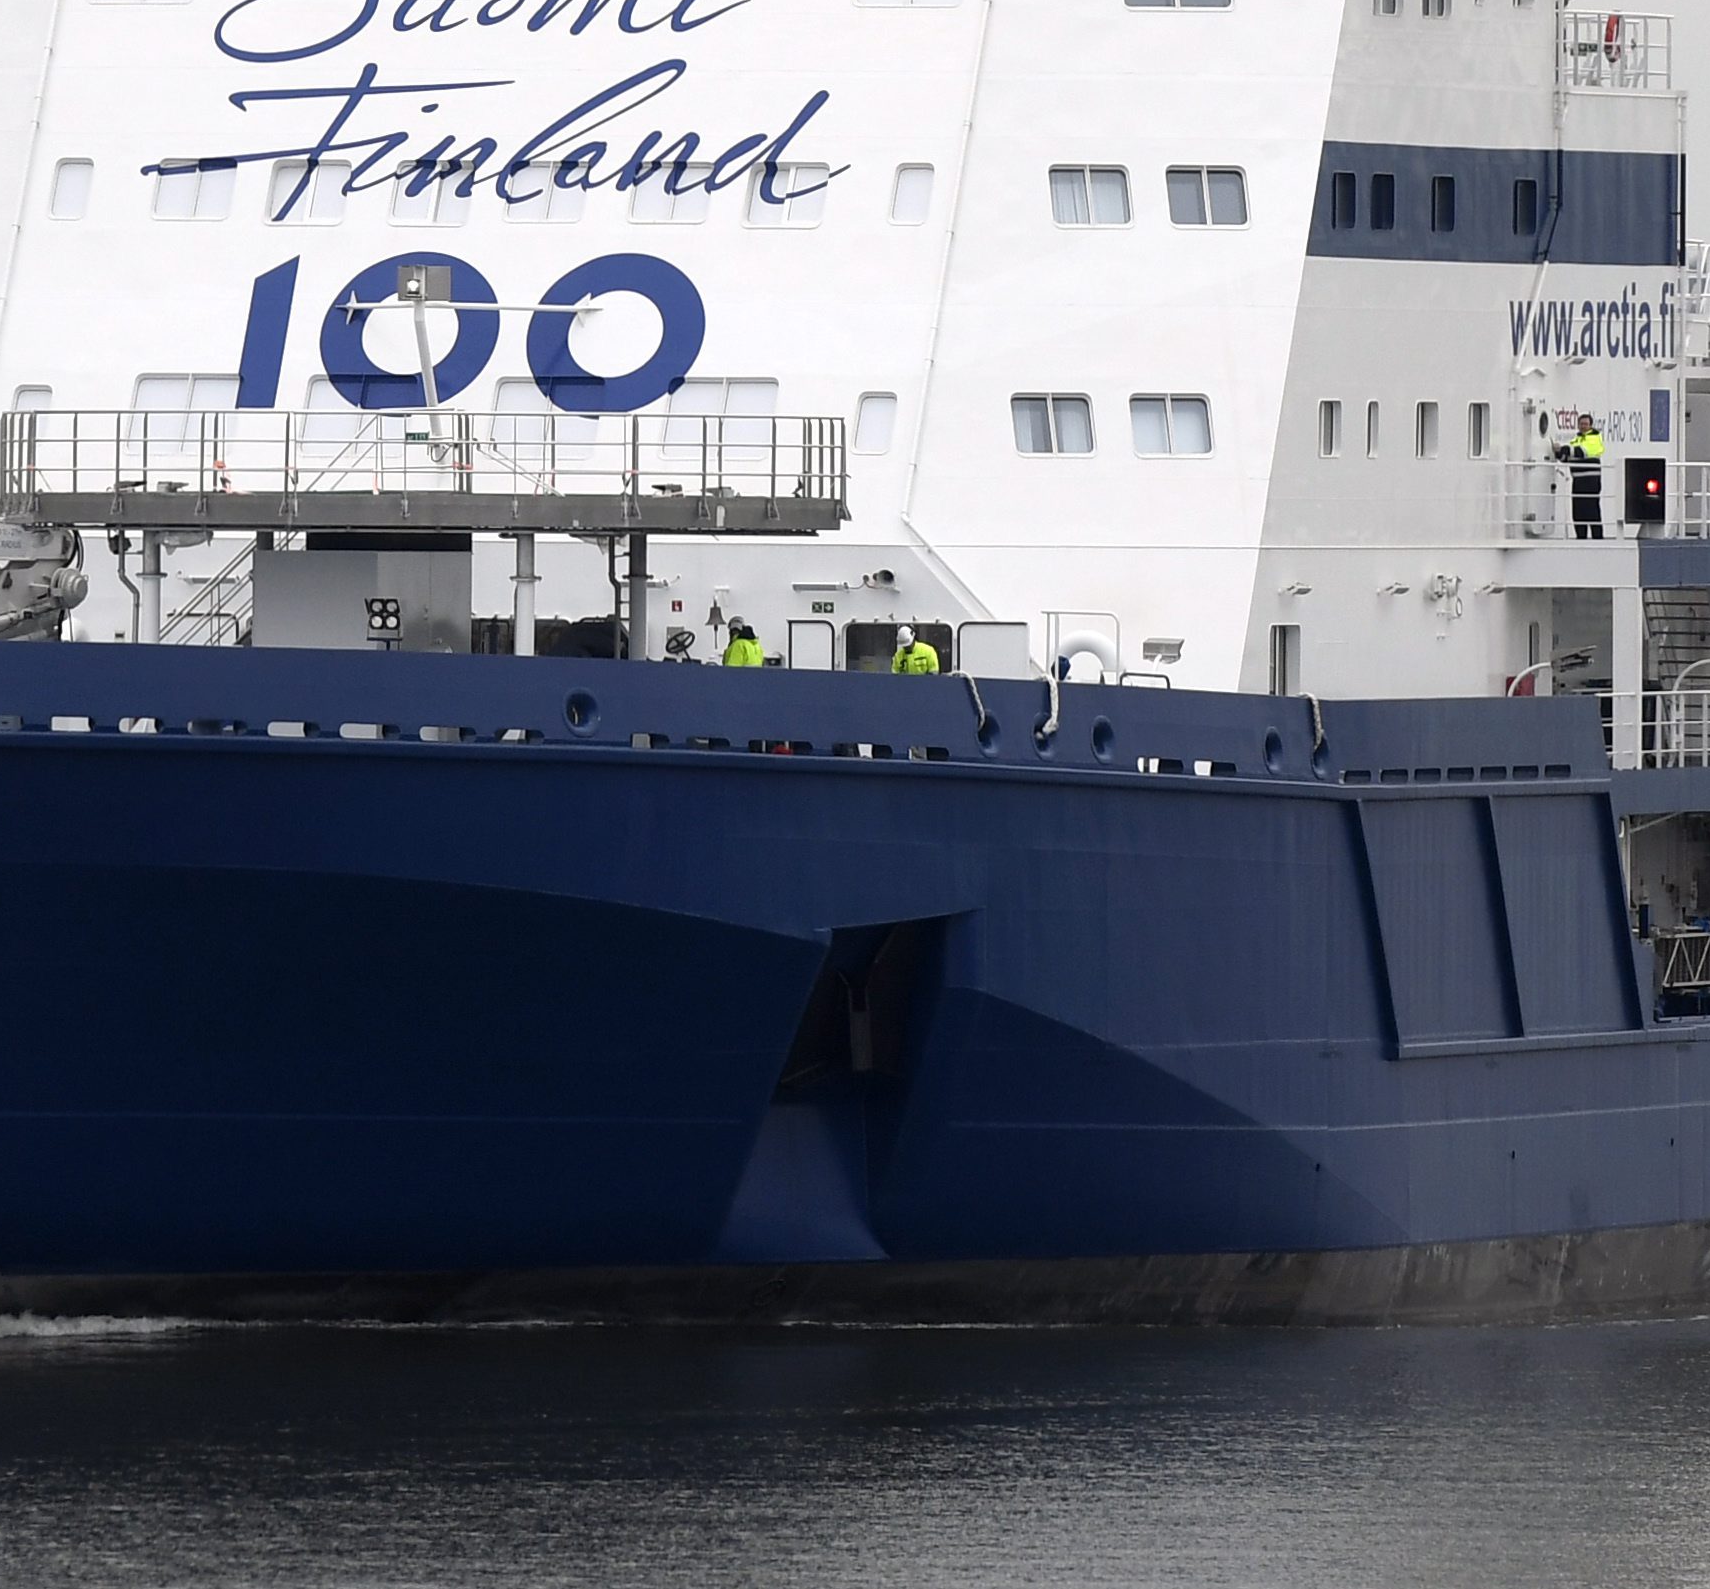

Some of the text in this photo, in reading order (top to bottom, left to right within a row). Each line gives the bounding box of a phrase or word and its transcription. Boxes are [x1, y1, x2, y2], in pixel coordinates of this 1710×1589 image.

[141, 58, 851, 223] Finland
[235, 250, 706, 418] 100
[1508, 280, 1675, 359] www.arctia.fi
